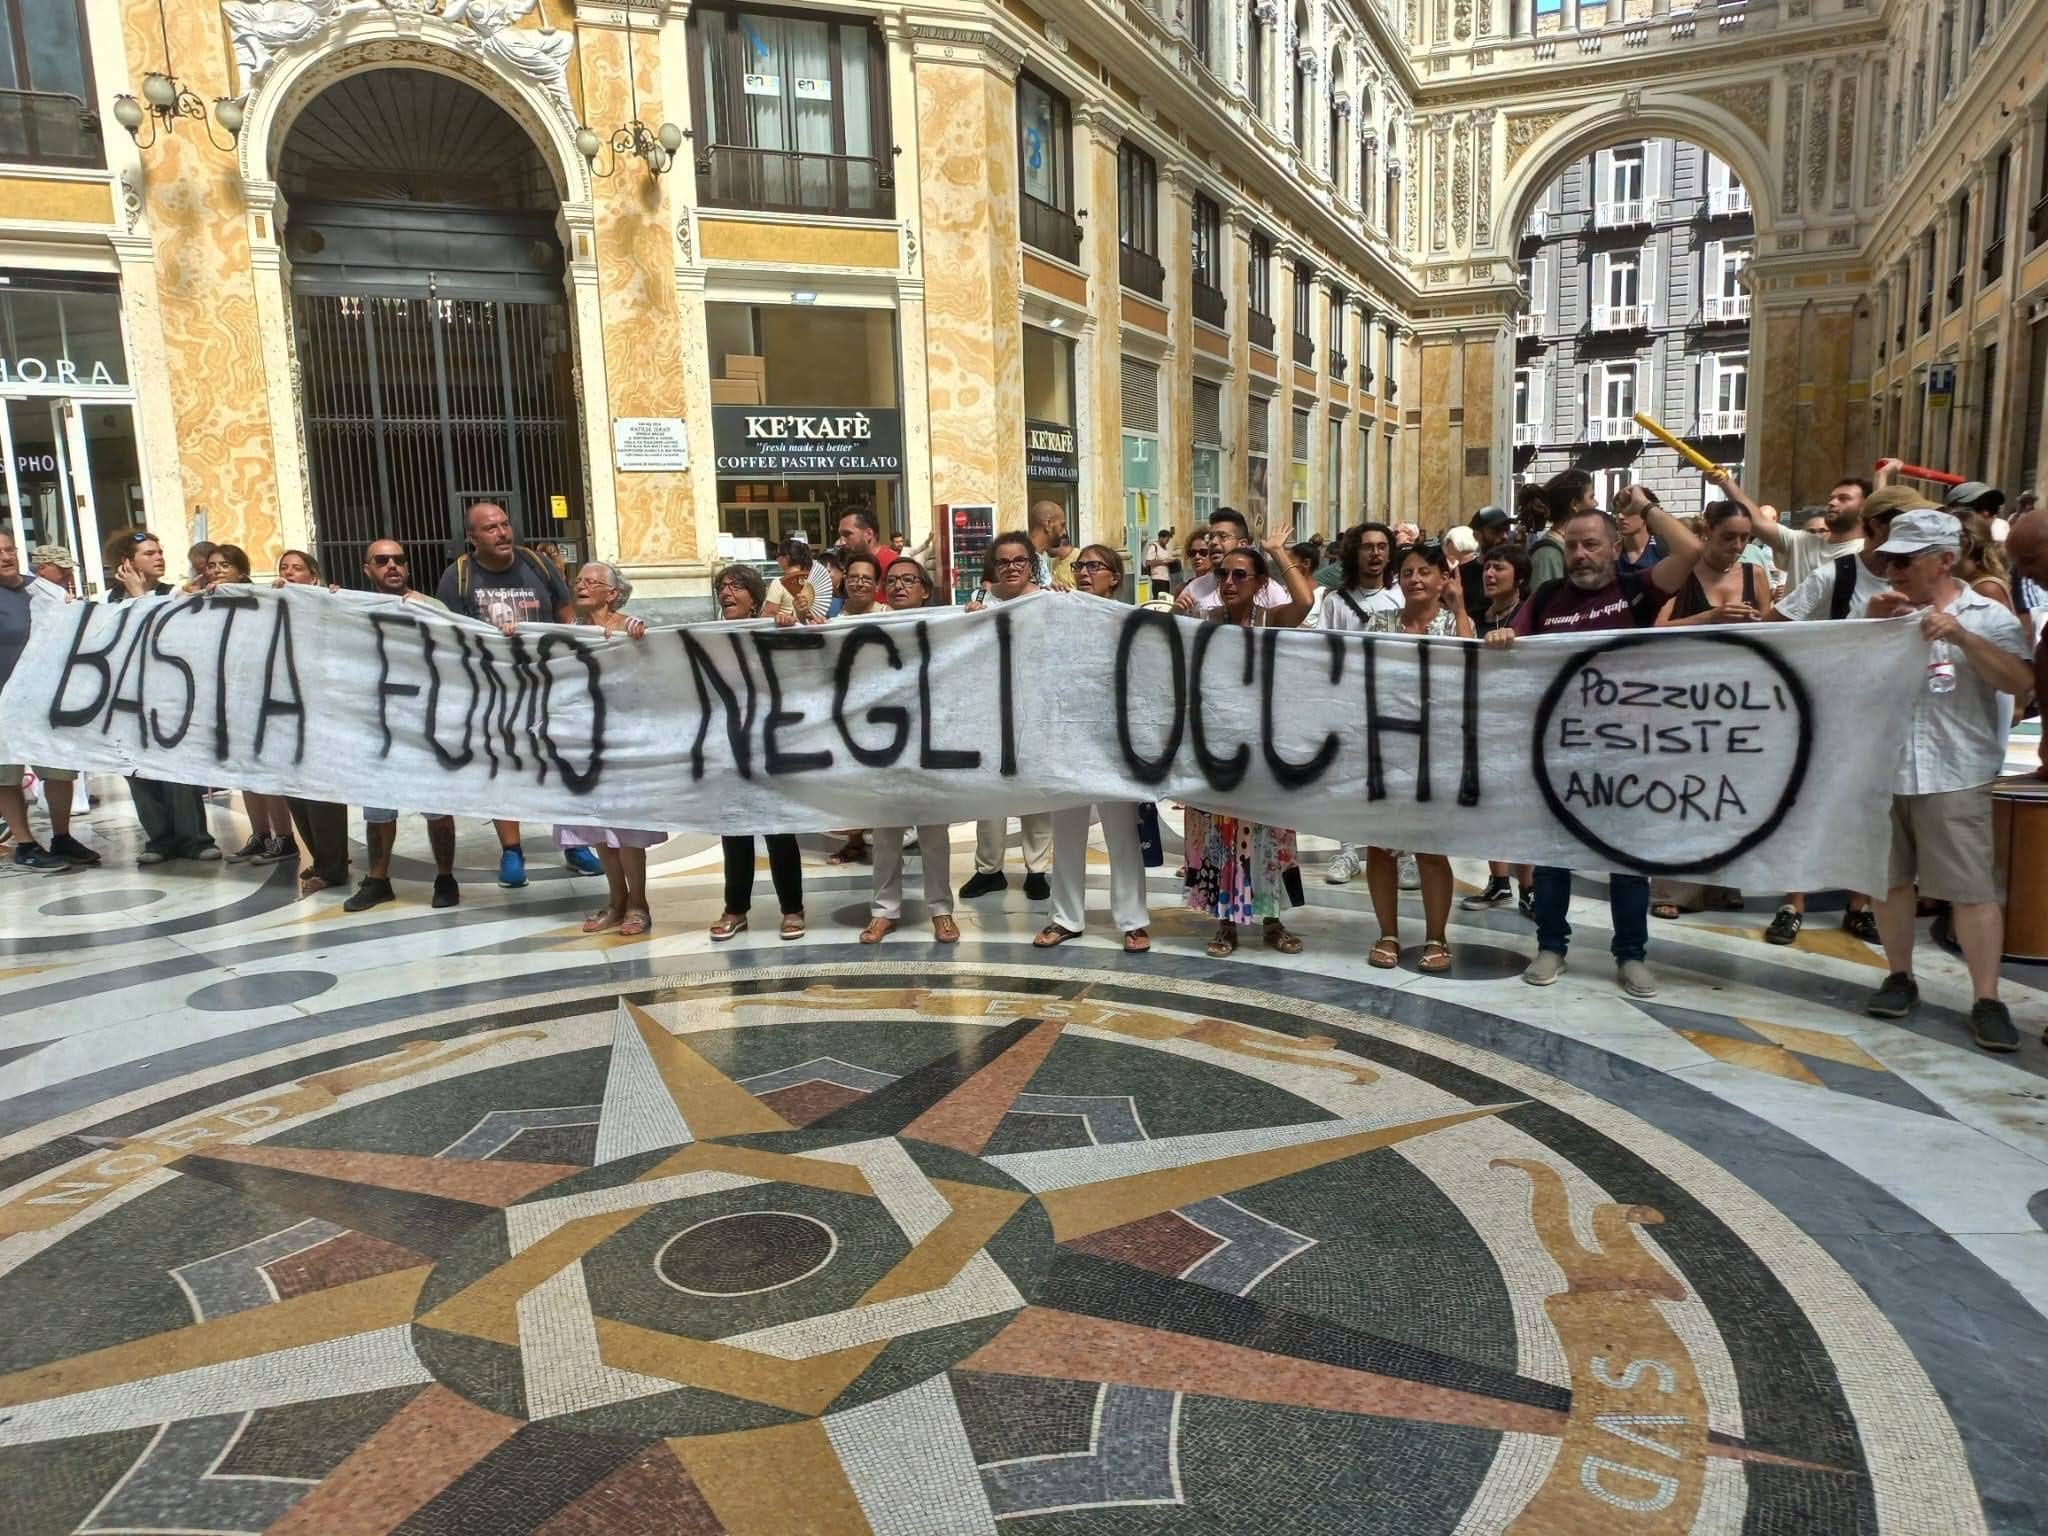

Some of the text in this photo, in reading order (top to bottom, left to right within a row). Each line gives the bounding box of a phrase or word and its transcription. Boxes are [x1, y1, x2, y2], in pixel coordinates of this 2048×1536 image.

[717, 456, 898, 469] COFFEE PASTRY GELATO
[788, 443, 814, 453] made
[815, 443, 824, 452] is
[487, 588, 534, 599] Vogliamo
[49, 596, 1480, 807] BASTA FUMO NEGLI OCCHI
[1580, 667, 1787, 712] POZZUOLI
[1559, 717, 1764, 755] ESISTE
[1564, 770, 1748, 822] ANCORA
[985, 999, 1133, 1024] EST
[24, 1105, 281, 1205] NORD
